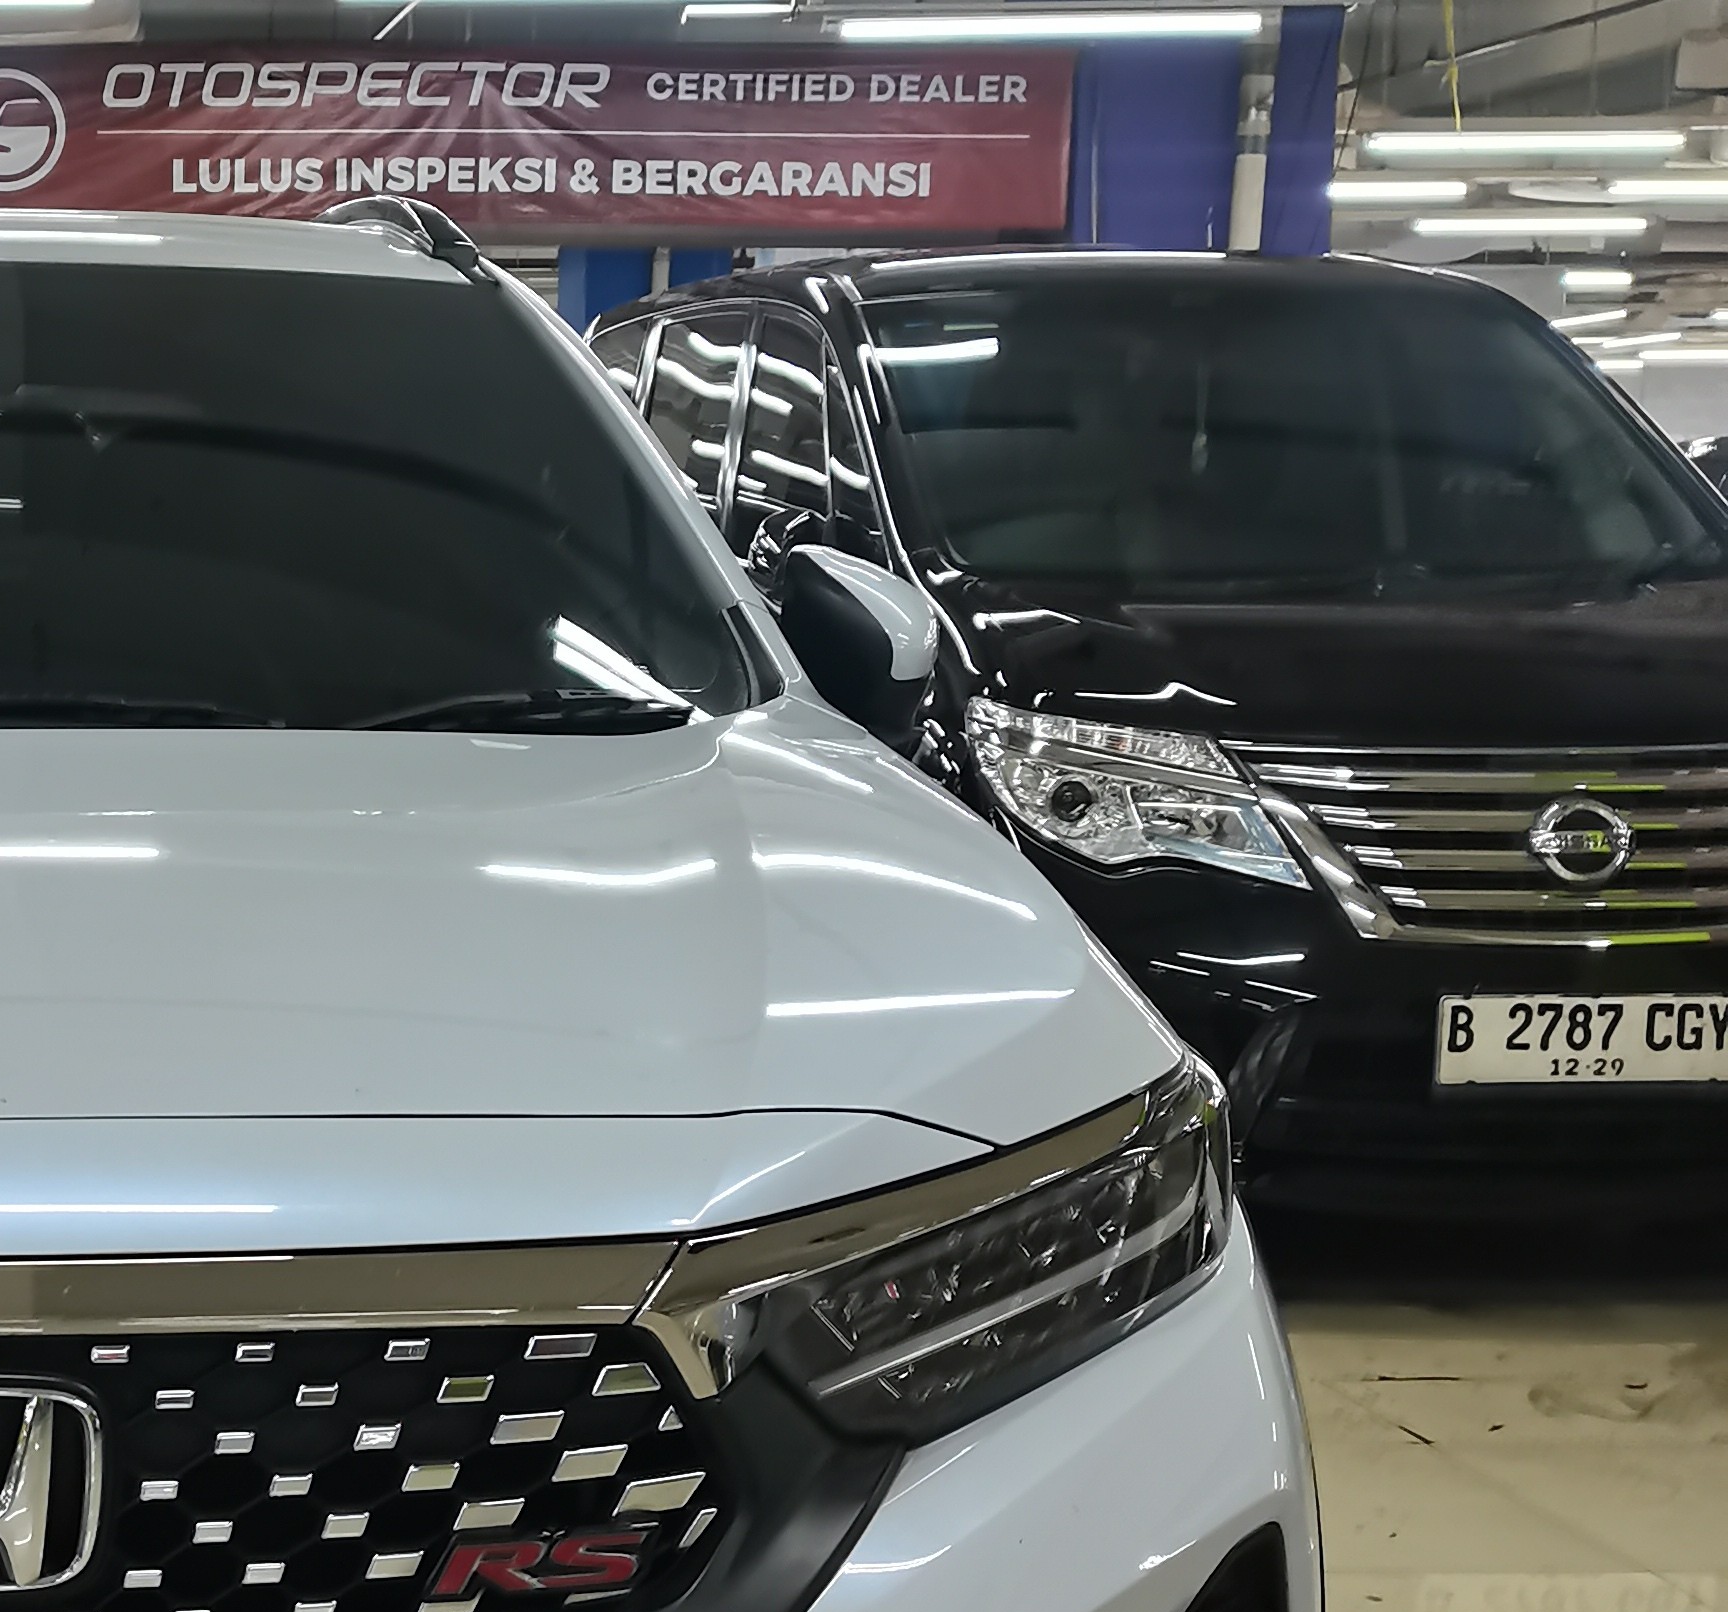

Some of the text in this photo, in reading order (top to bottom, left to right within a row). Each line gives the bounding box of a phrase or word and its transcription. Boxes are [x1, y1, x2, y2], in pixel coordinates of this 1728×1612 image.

[102, 61, 1028, 109] OTOSPECTOR CERTIFIED DEALER
[172, 155, 932, 199] LULUS INSPEKSI & BERGARANSI
[1446, 1002, 1728, 1053] B 2787 CGY
[431, 1530, 649, 1596] RS
